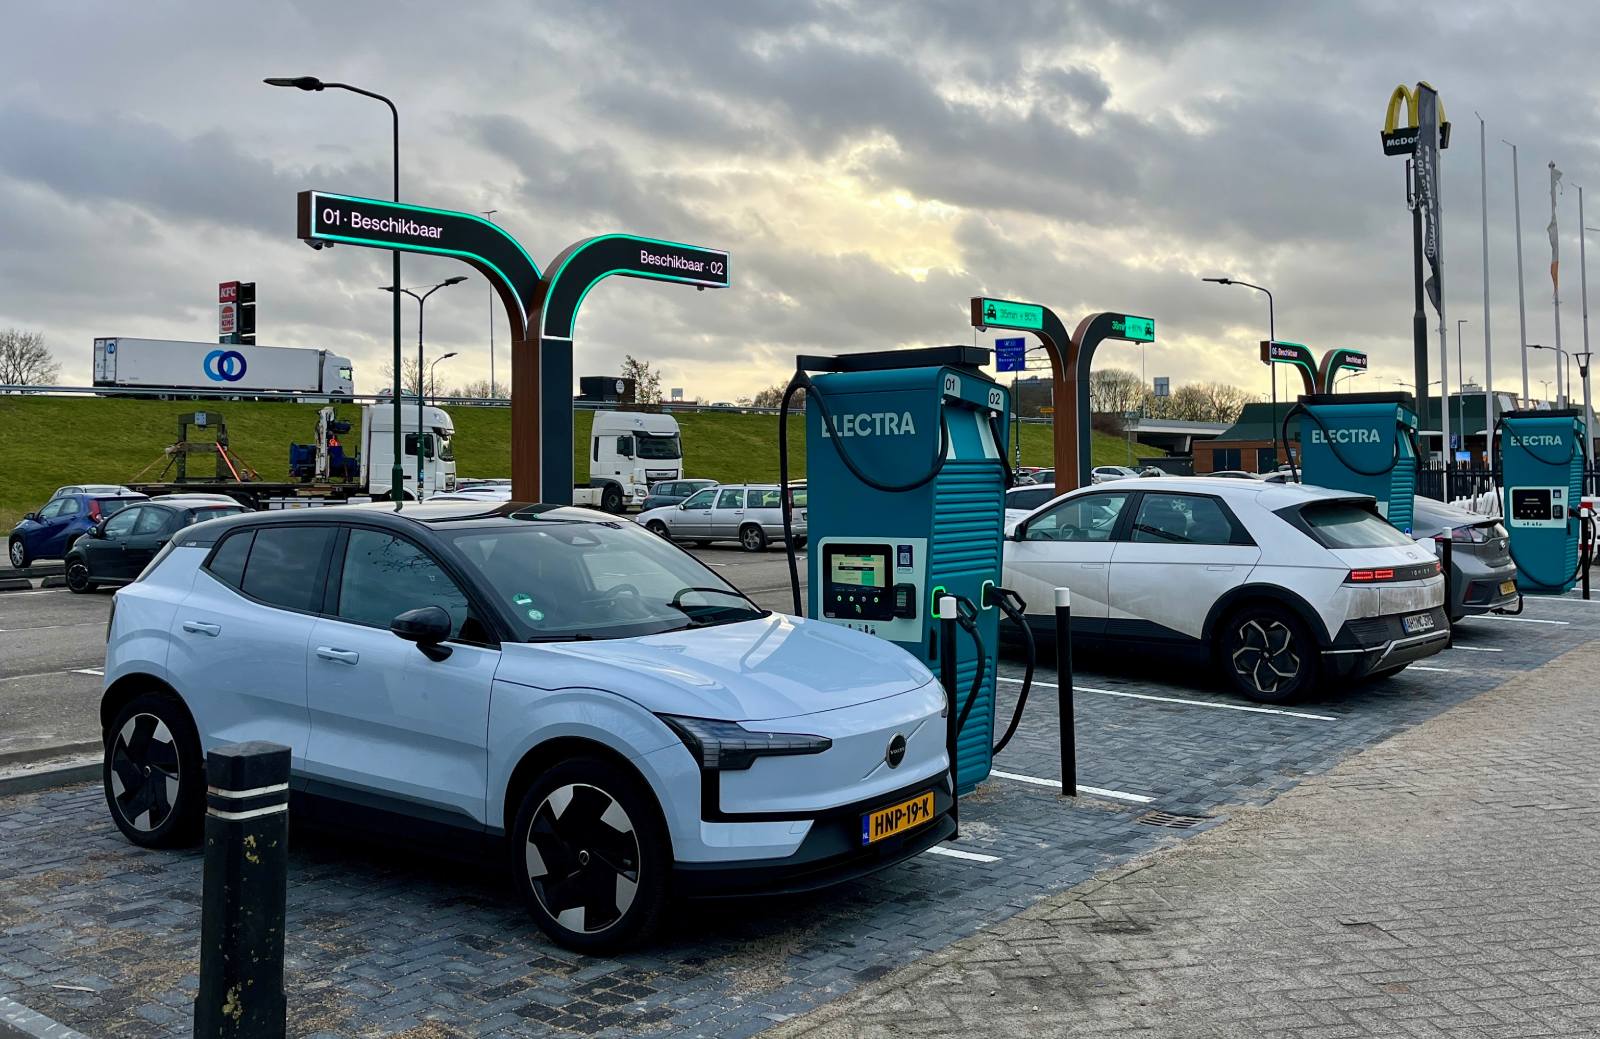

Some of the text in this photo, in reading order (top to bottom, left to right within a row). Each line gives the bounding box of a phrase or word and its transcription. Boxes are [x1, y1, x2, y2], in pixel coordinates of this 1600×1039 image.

[322, 208, 443, 239] 01 Beschikbaar
[640, 249, 724, 275] Beschikbaar 02
[220, 287, 236, 298] KFC
[945, 377, 956, 391] 01
[989, 392, 1000, 405] 02
[821, 411, 915, 438] ELECTRA
[1311, 428, 1380, 444] ELECTRA
[874, 797, 930, 837] HNP-19-K
